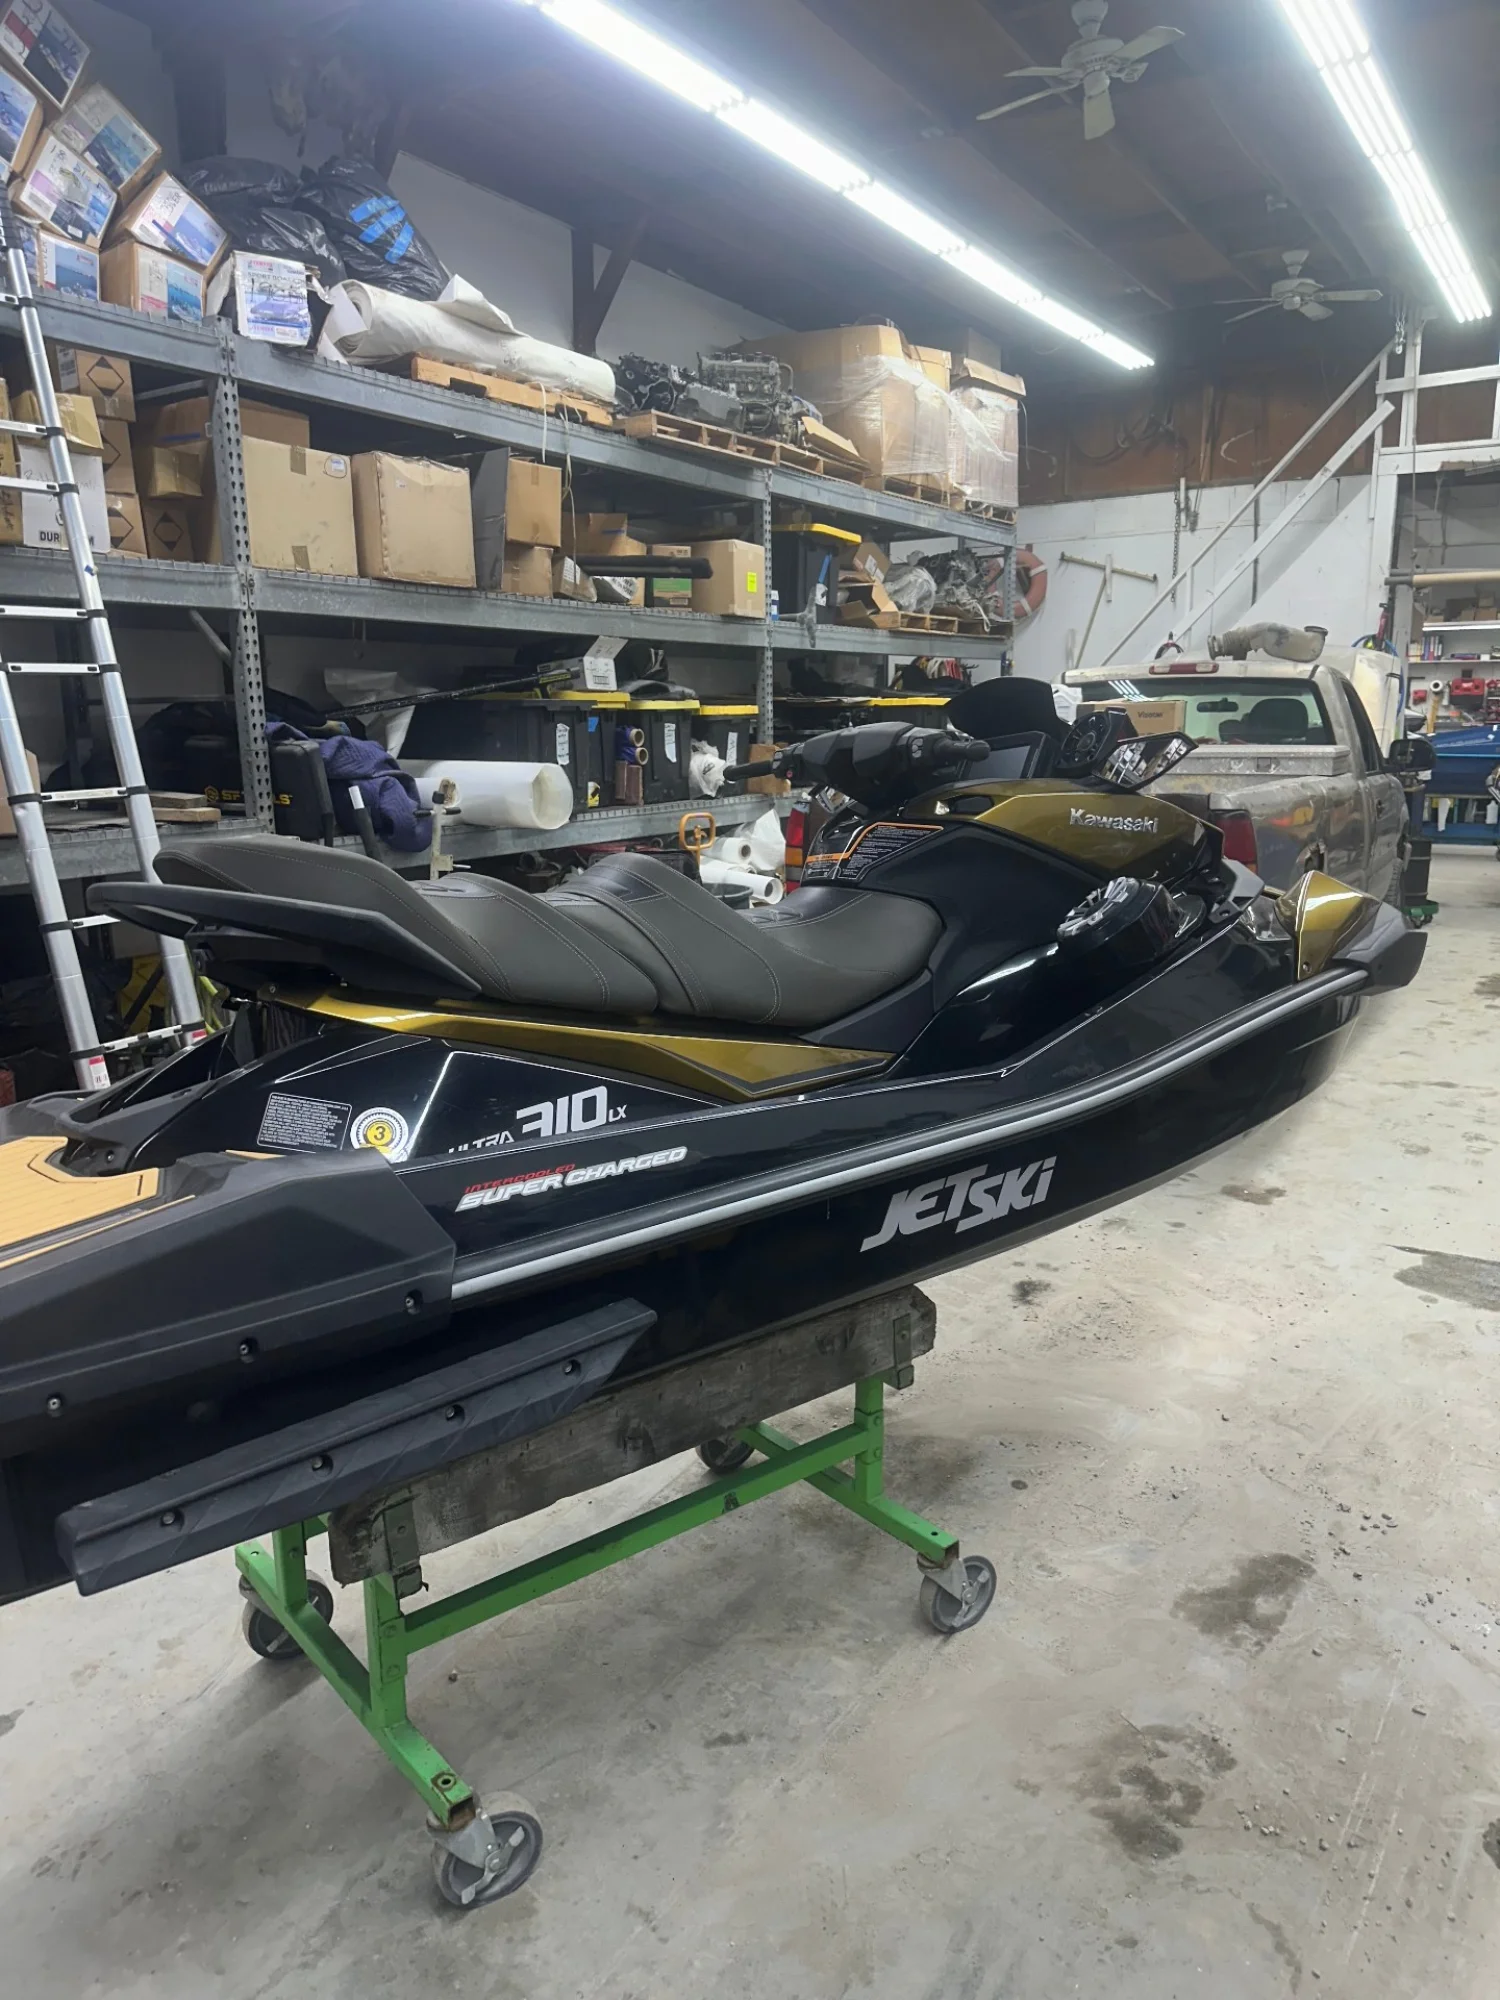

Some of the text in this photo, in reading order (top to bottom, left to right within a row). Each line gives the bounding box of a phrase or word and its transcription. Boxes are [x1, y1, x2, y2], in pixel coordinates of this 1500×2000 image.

[1069, 808, 1159, 833] Kawasaki
[373, 1125, 387, 1141] 3
[455, 1146, 688, 1212] SUPER CHARGED
[464, 1163, 576, 1194] INTERCOOLED
